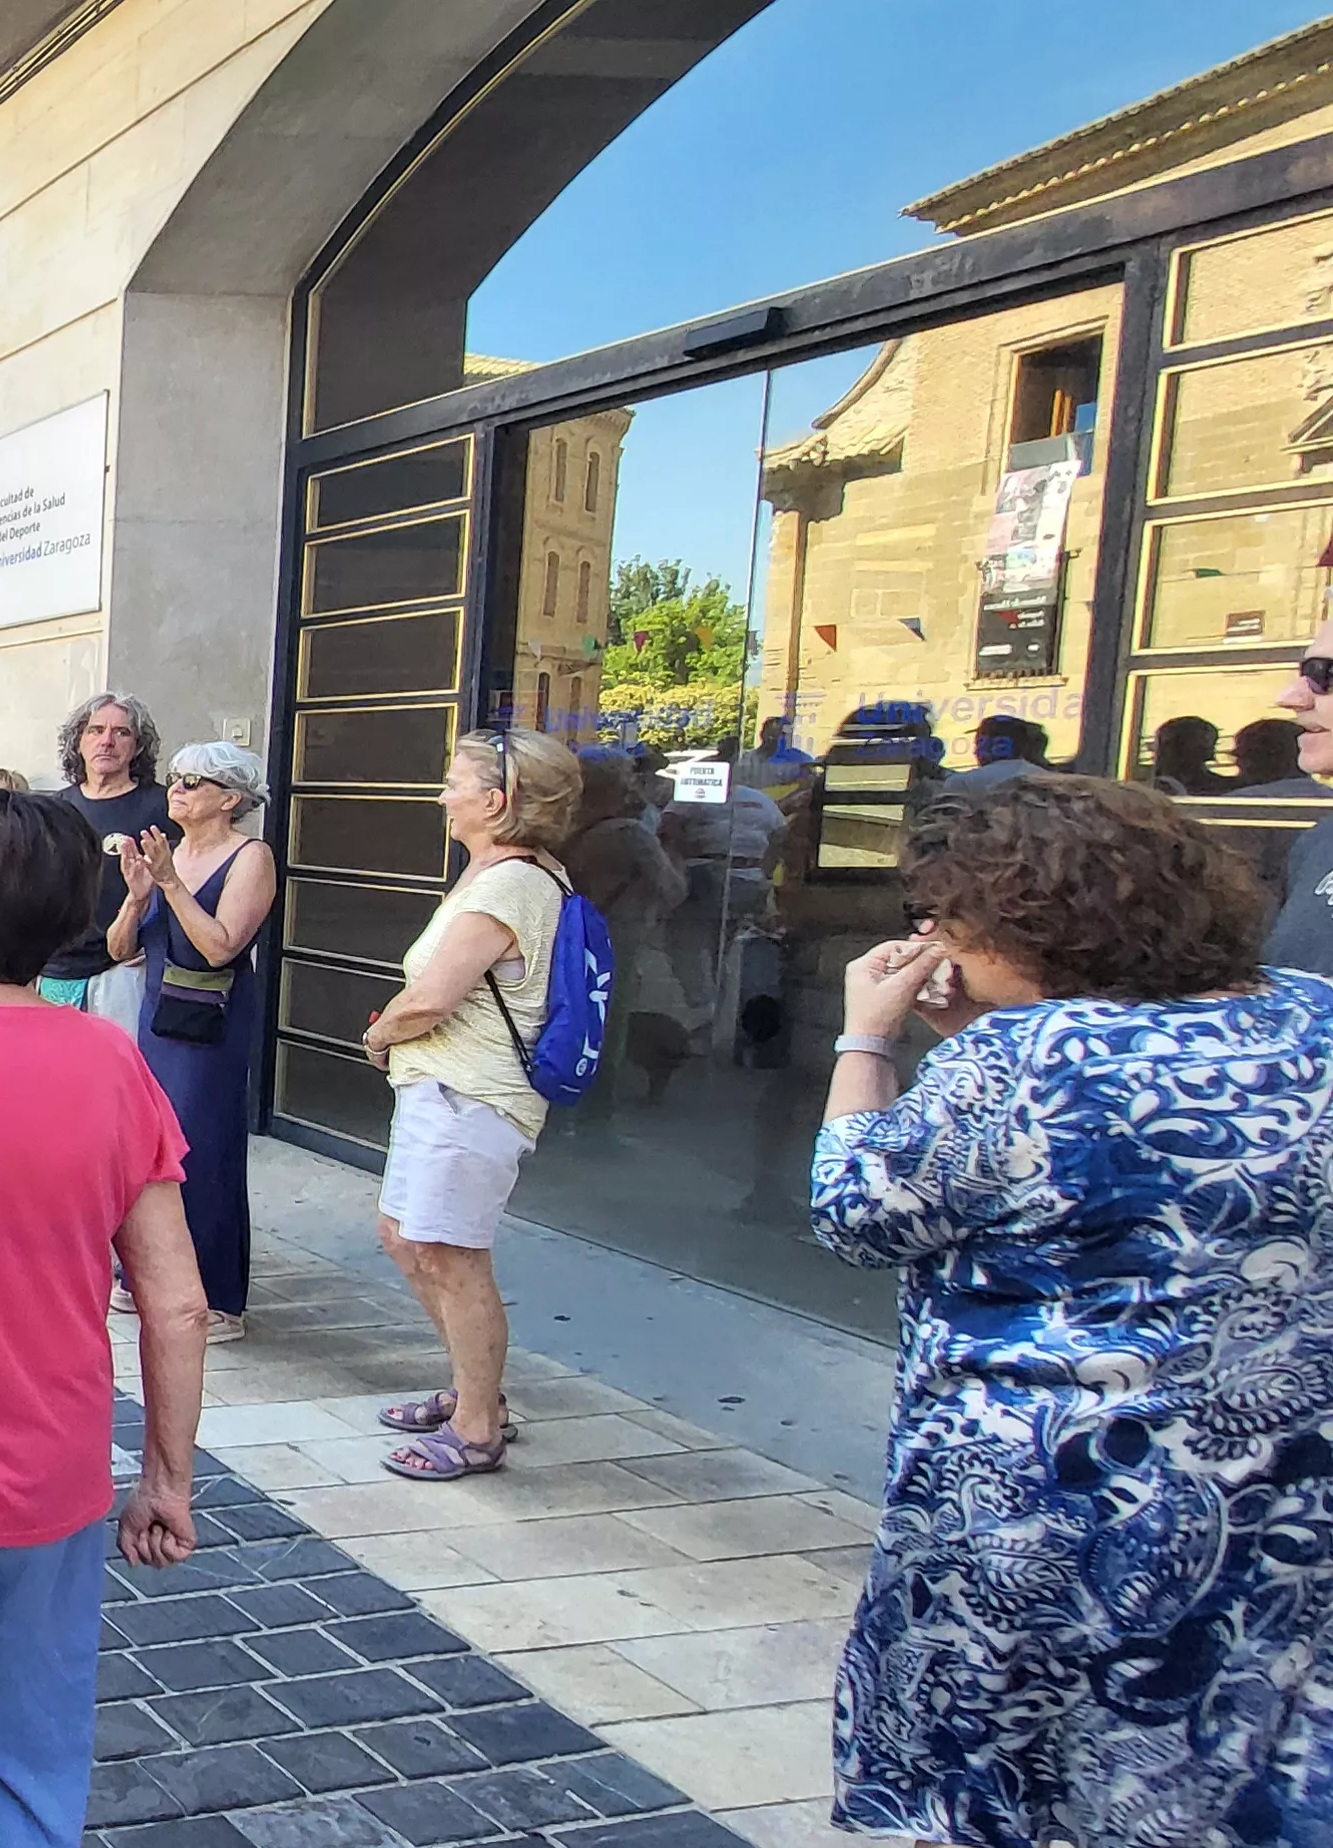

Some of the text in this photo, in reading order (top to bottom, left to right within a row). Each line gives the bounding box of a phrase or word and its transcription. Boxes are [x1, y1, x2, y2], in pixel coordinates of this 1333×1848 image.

[24, 486, 34, 500] de
[22, 504, 32, 518] de
[33, 501, 41, 514] la
[42, 492, 66, 512] Salud
[9, 521, 41, 540] Deporte
[43, 533, 91, 557] Zaragoza
